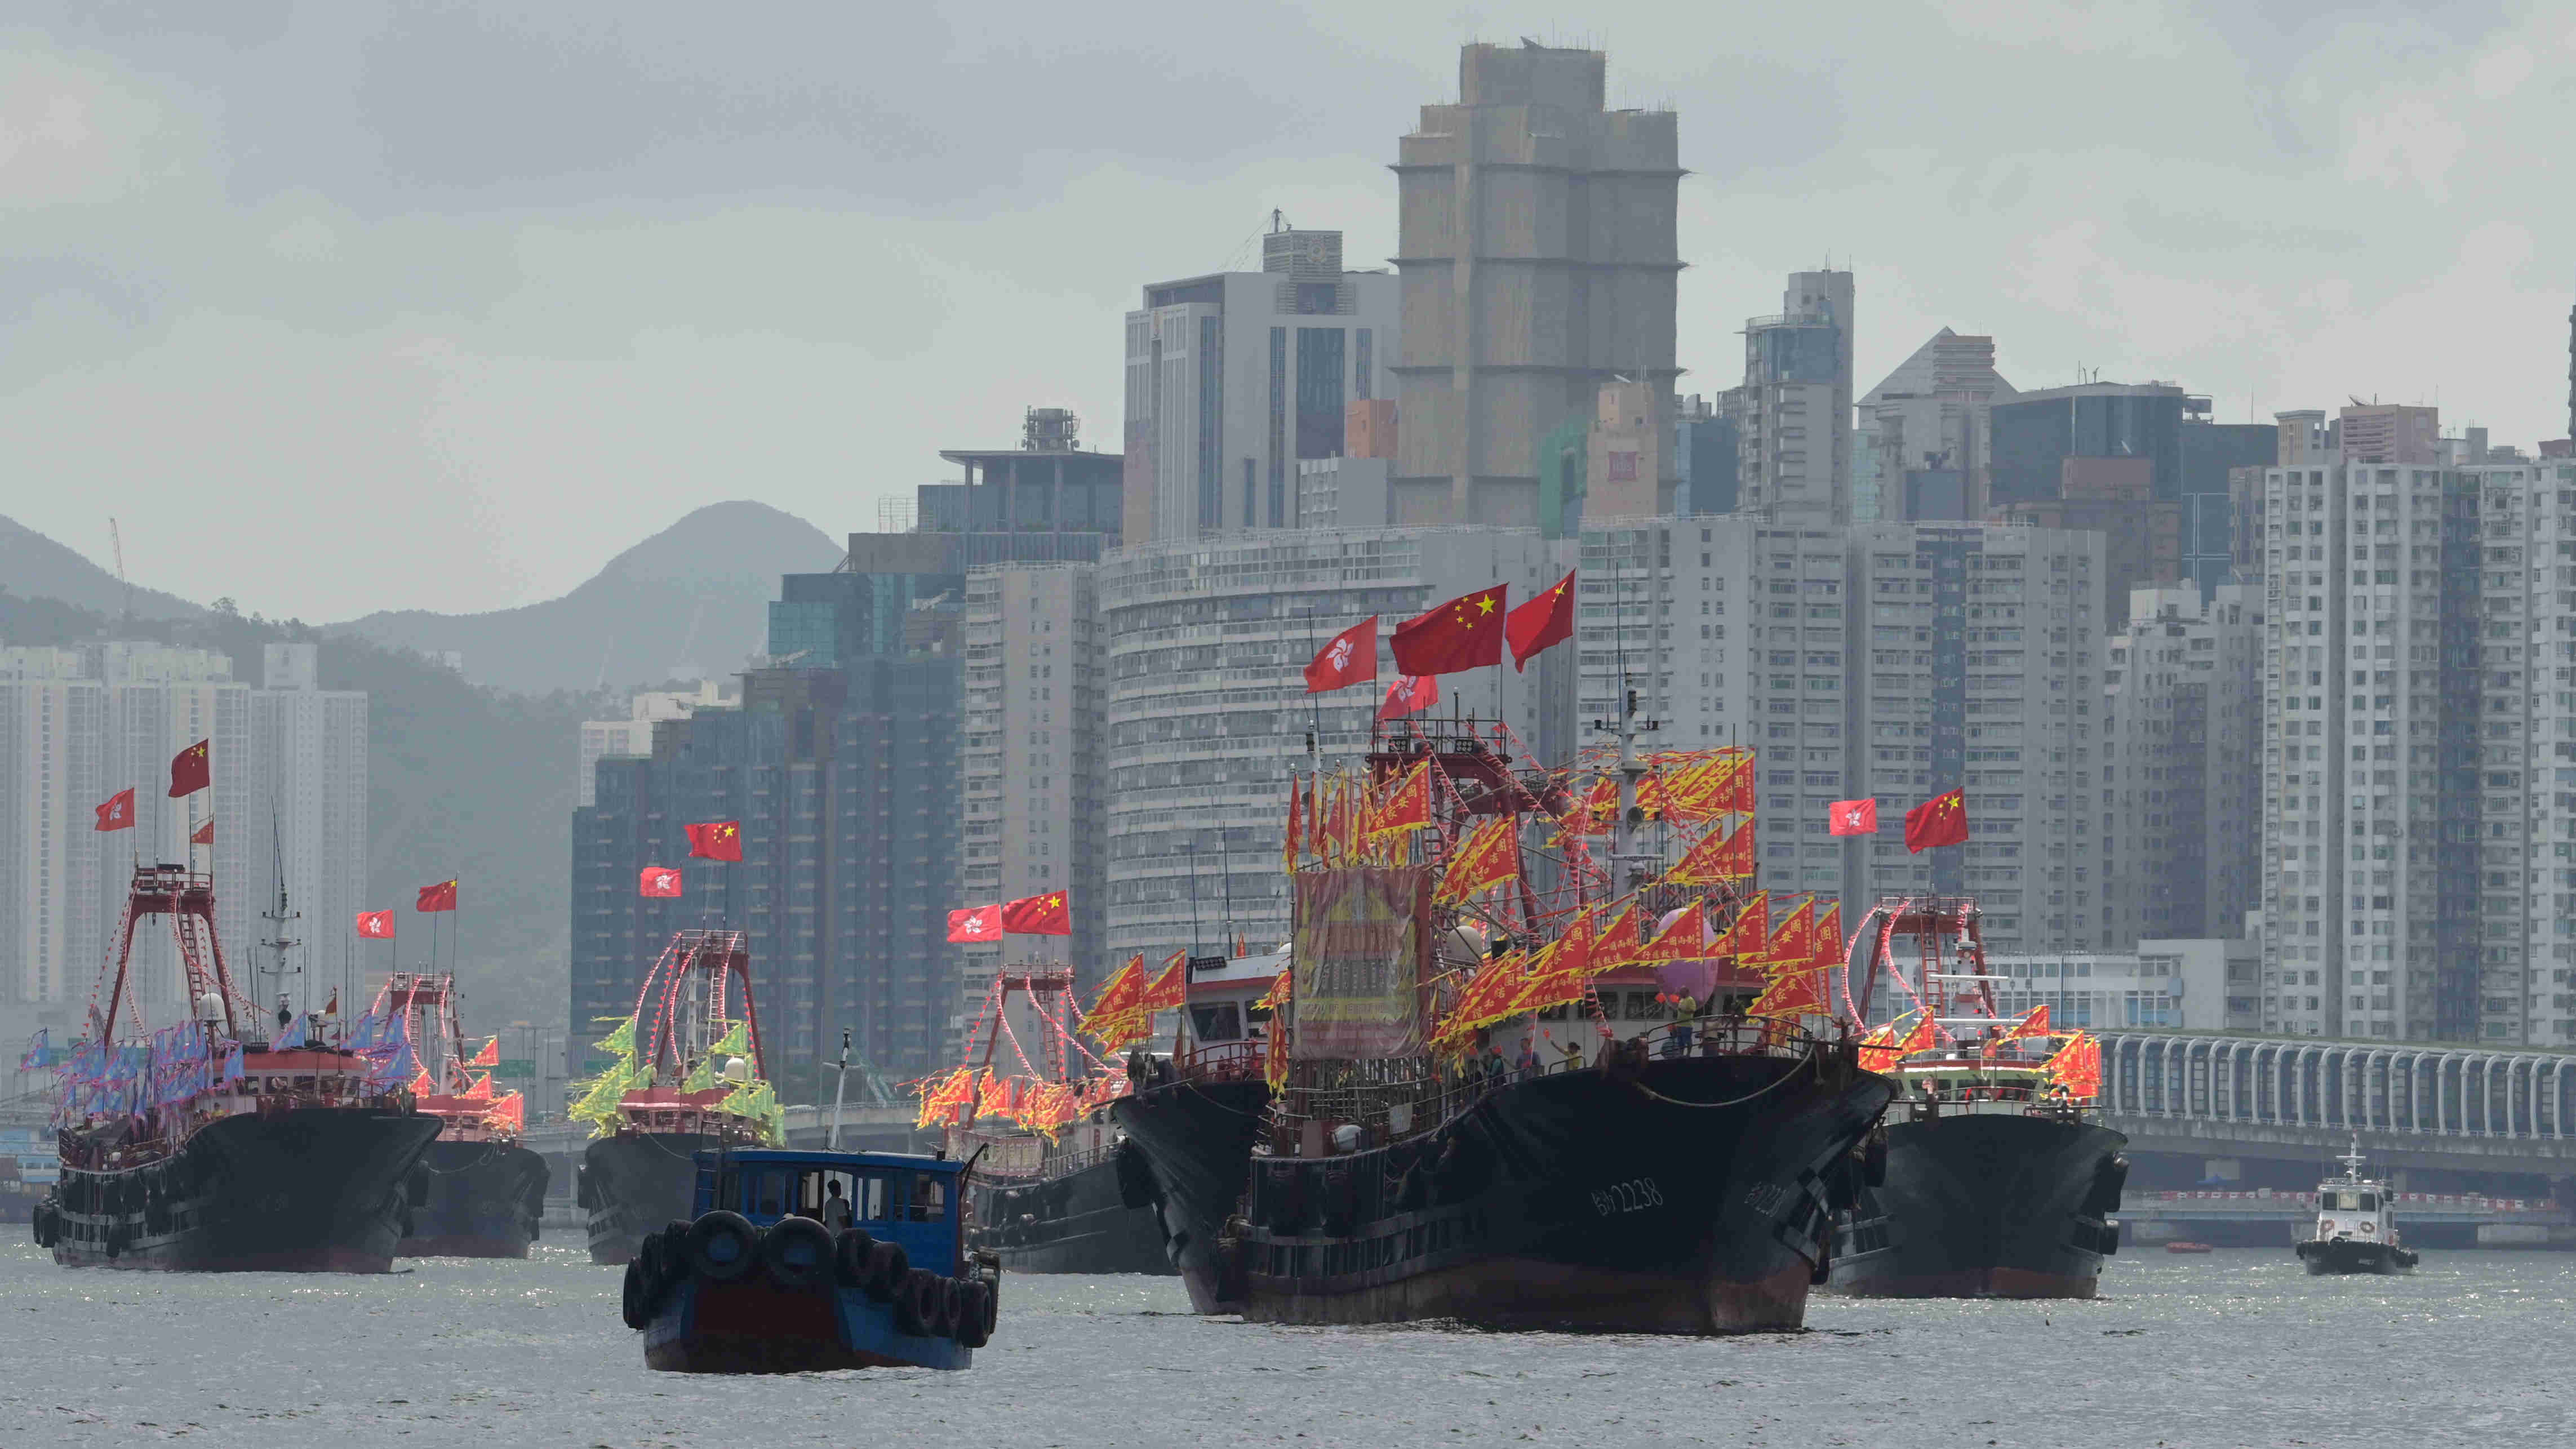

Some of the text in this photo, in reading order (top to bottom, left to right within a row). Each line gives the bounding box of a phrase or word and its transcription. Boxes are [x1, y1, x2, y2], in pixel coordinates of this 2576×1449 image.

[1375, 784, 1417, 828] 國安家好
[1659, 935, 1695, 946] 一國兩制
